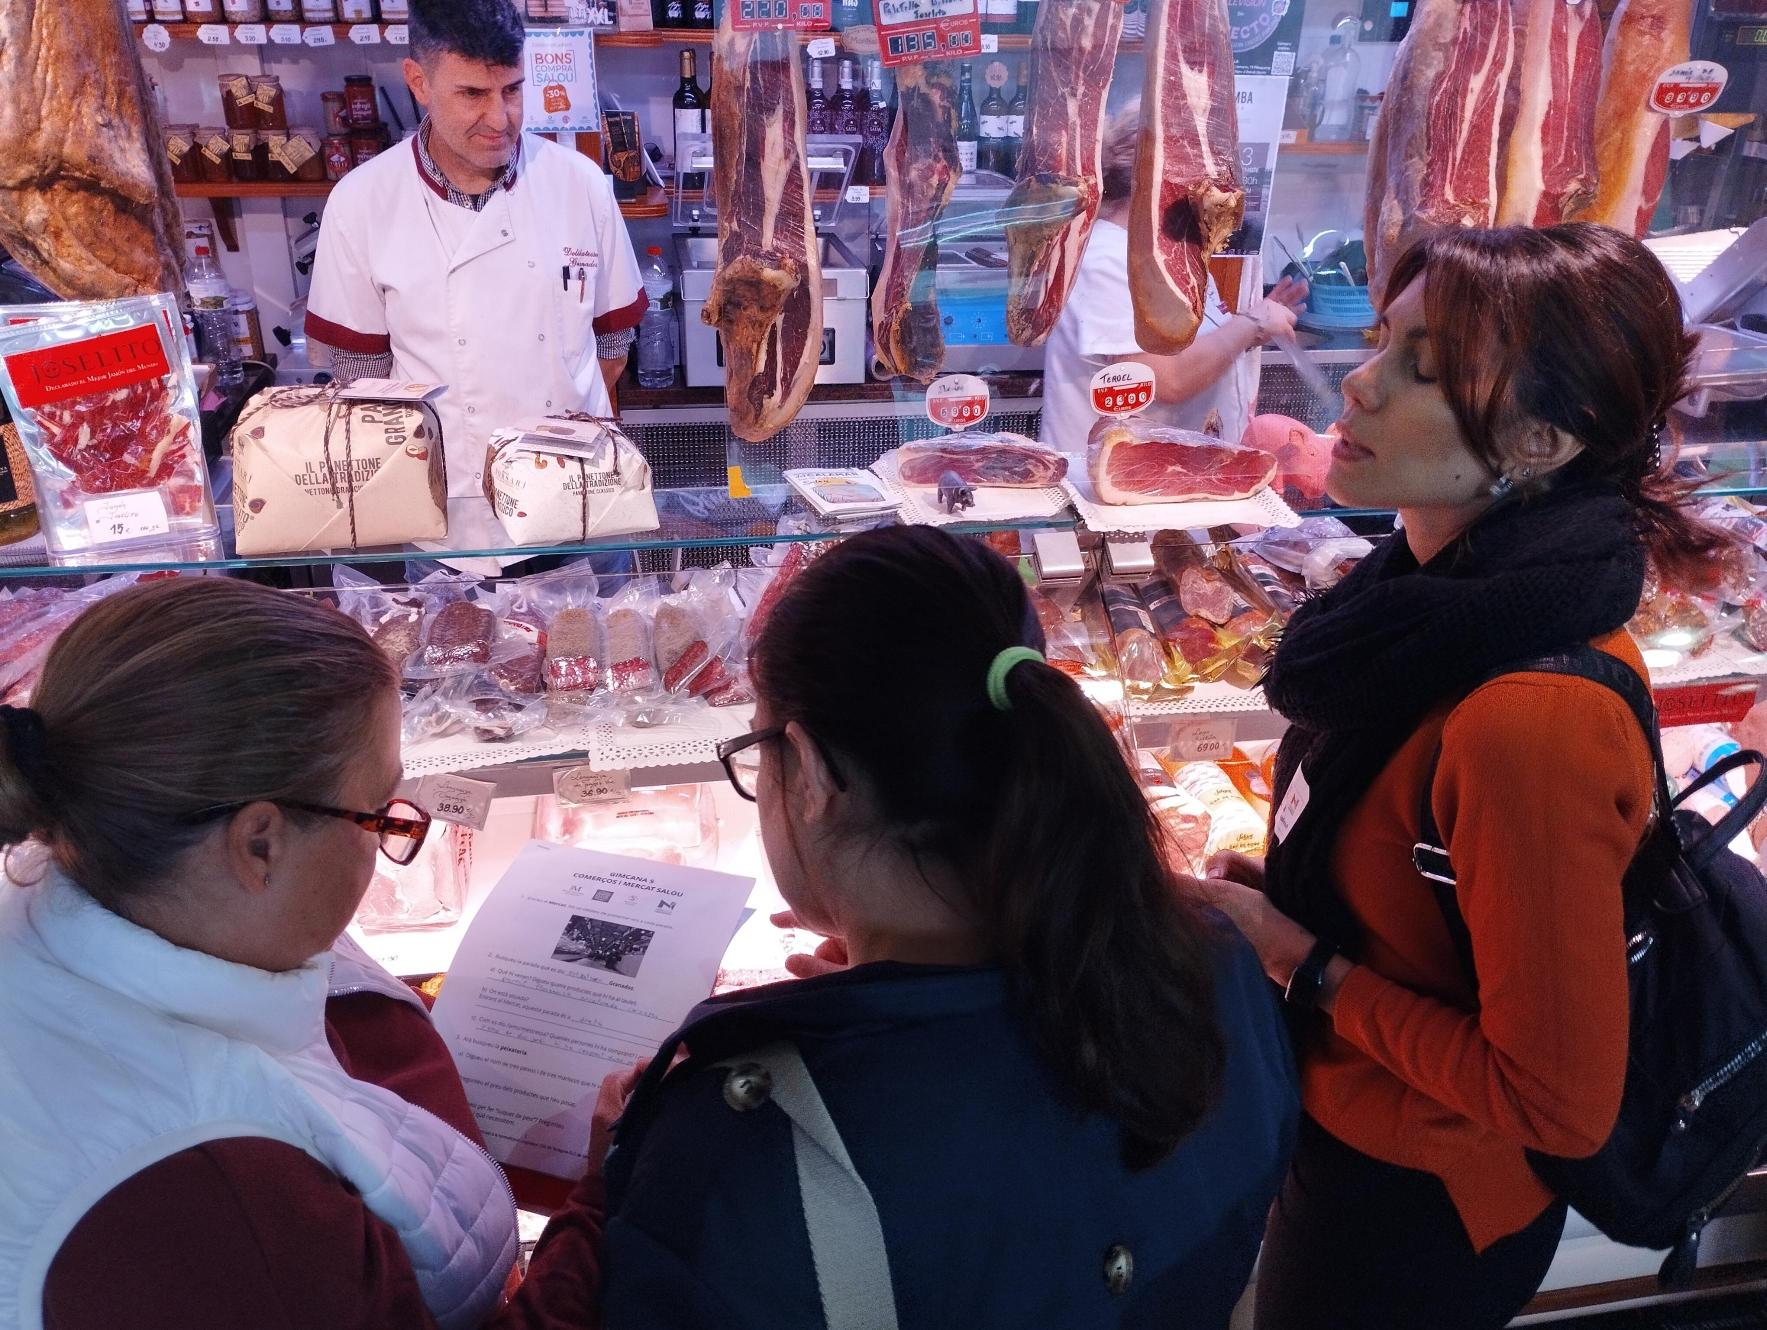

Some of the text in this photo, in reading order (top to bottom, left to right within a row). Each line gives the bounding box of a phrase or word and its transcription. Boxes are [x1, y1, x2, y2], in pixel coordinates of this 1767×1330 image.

[534, 52, 572, 65] BONS
[946, 49, 963, 57] KILO
[534, 64, 574, 72] COMPRA
[536, 72, 574, 83] SALOU
[31, 337, 162, 385] JOSELITO
[305, 461, 316, 474] IL
[294, 473, 330, 486] DELLA
[436, 802, 465, 815] 38.90
[609, 871, 649, 884] GIMCANA
[572, 872, 618, 886] COMERÇOS
[622, 881, 656, 892] MERCAT
[656, 887, 684, 898] SALOU
